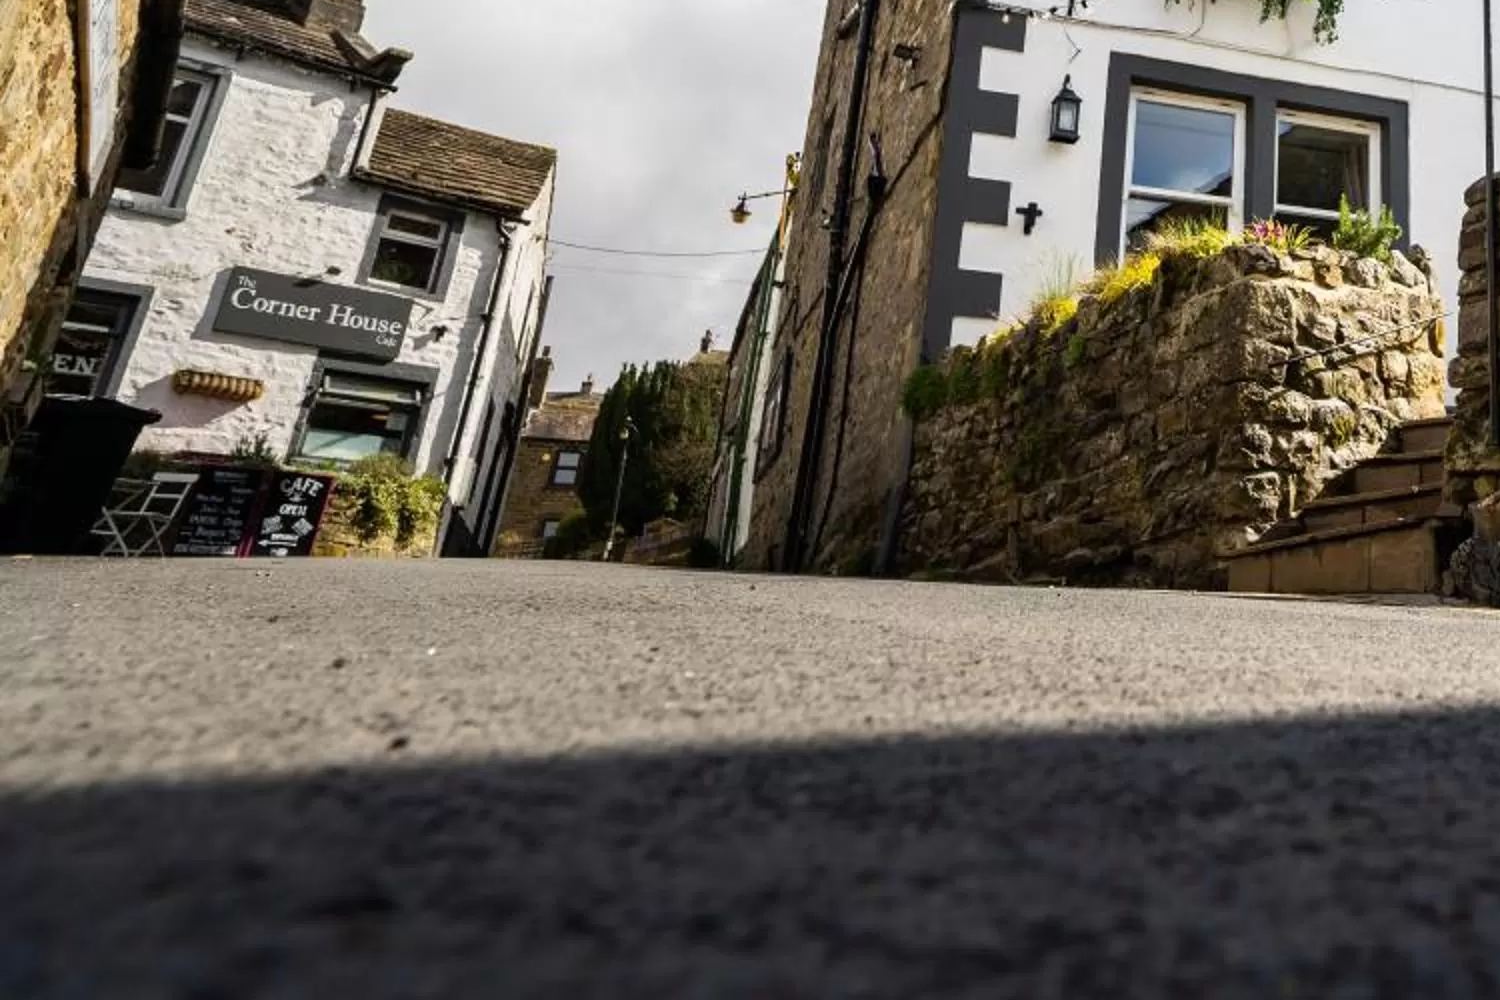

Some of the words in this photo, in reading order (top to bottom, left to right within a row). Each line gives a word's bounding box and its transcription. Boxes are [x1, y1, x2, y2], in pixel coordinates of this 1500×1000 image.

[237, 276, 256, 288] The
[231, 287, 320, 321] Corner
[326, 303, 402, 335] House
[280, 477, 324, 497] CAFE
[279, 503, 308, 517] OPEN
